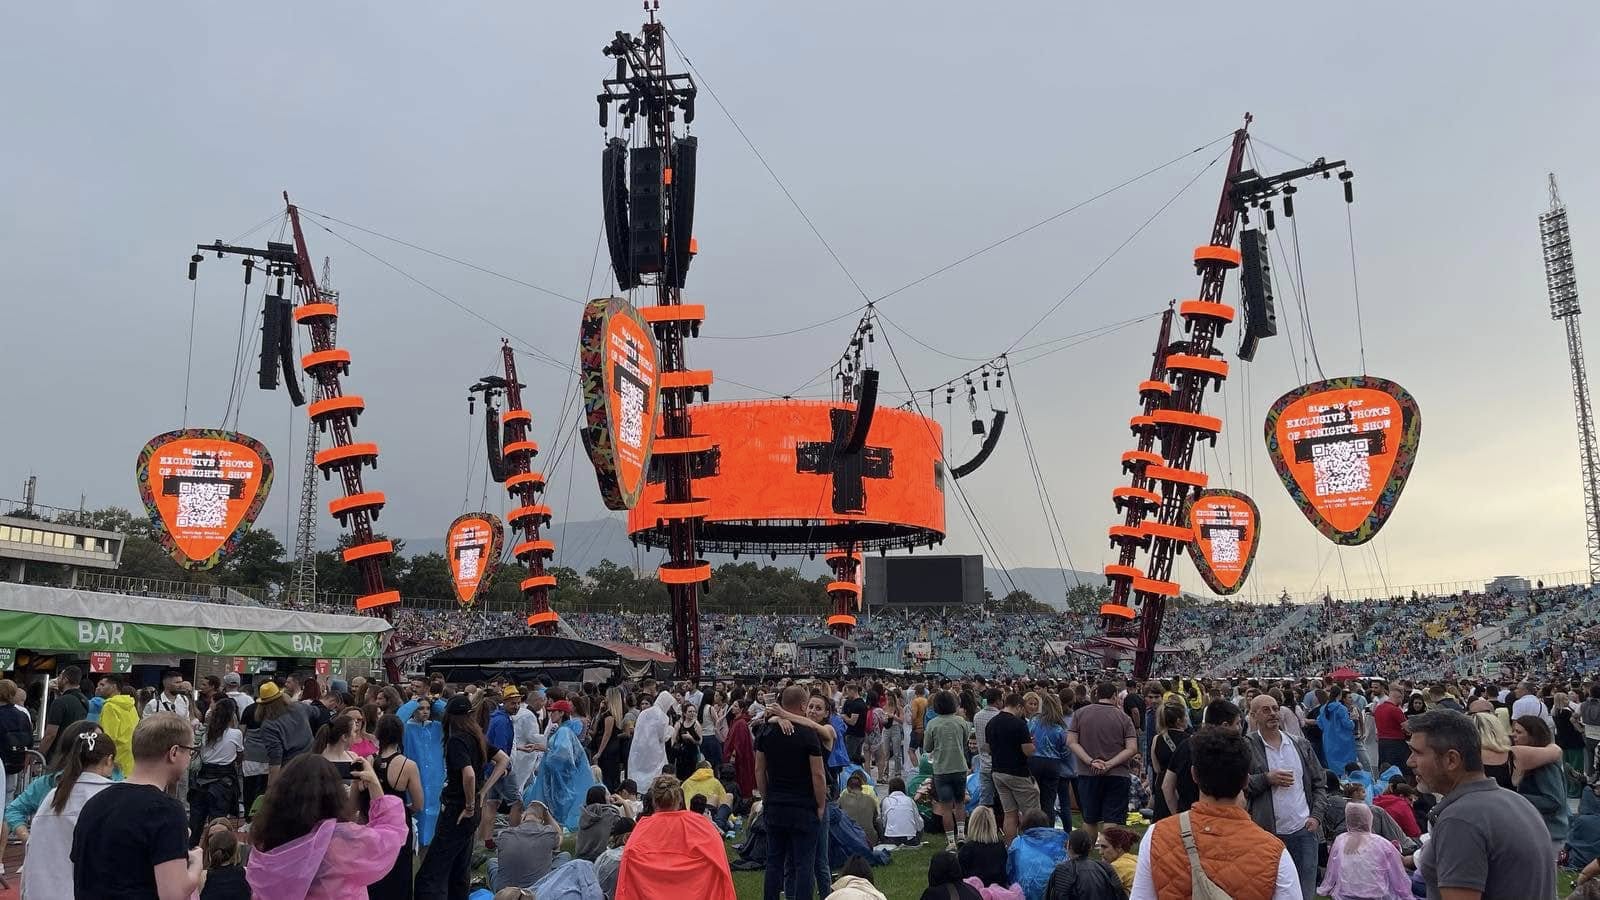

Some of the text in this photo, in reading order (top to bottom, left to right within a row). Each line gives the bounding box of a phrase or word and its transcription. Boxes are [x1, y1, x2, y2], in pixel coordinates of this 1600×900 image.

[1308, 404, 1330, 412] Sign
[1334, 402, 1344, 411] up
[1286, 406, 1390, 429] EXCLUSIVE PHOTOS
[1288, 419, 1391, 440] OF TONIGHT'S SHOW
[183, 448, 202, 456] Sign
[160, 456, 254, 468] EXCLUSIVE PHOTOS
[176, 468, 224, 478] TONIGHT'S
[78, 620, 125, 644] BAR
[292, 635, 324, 653] BAR
